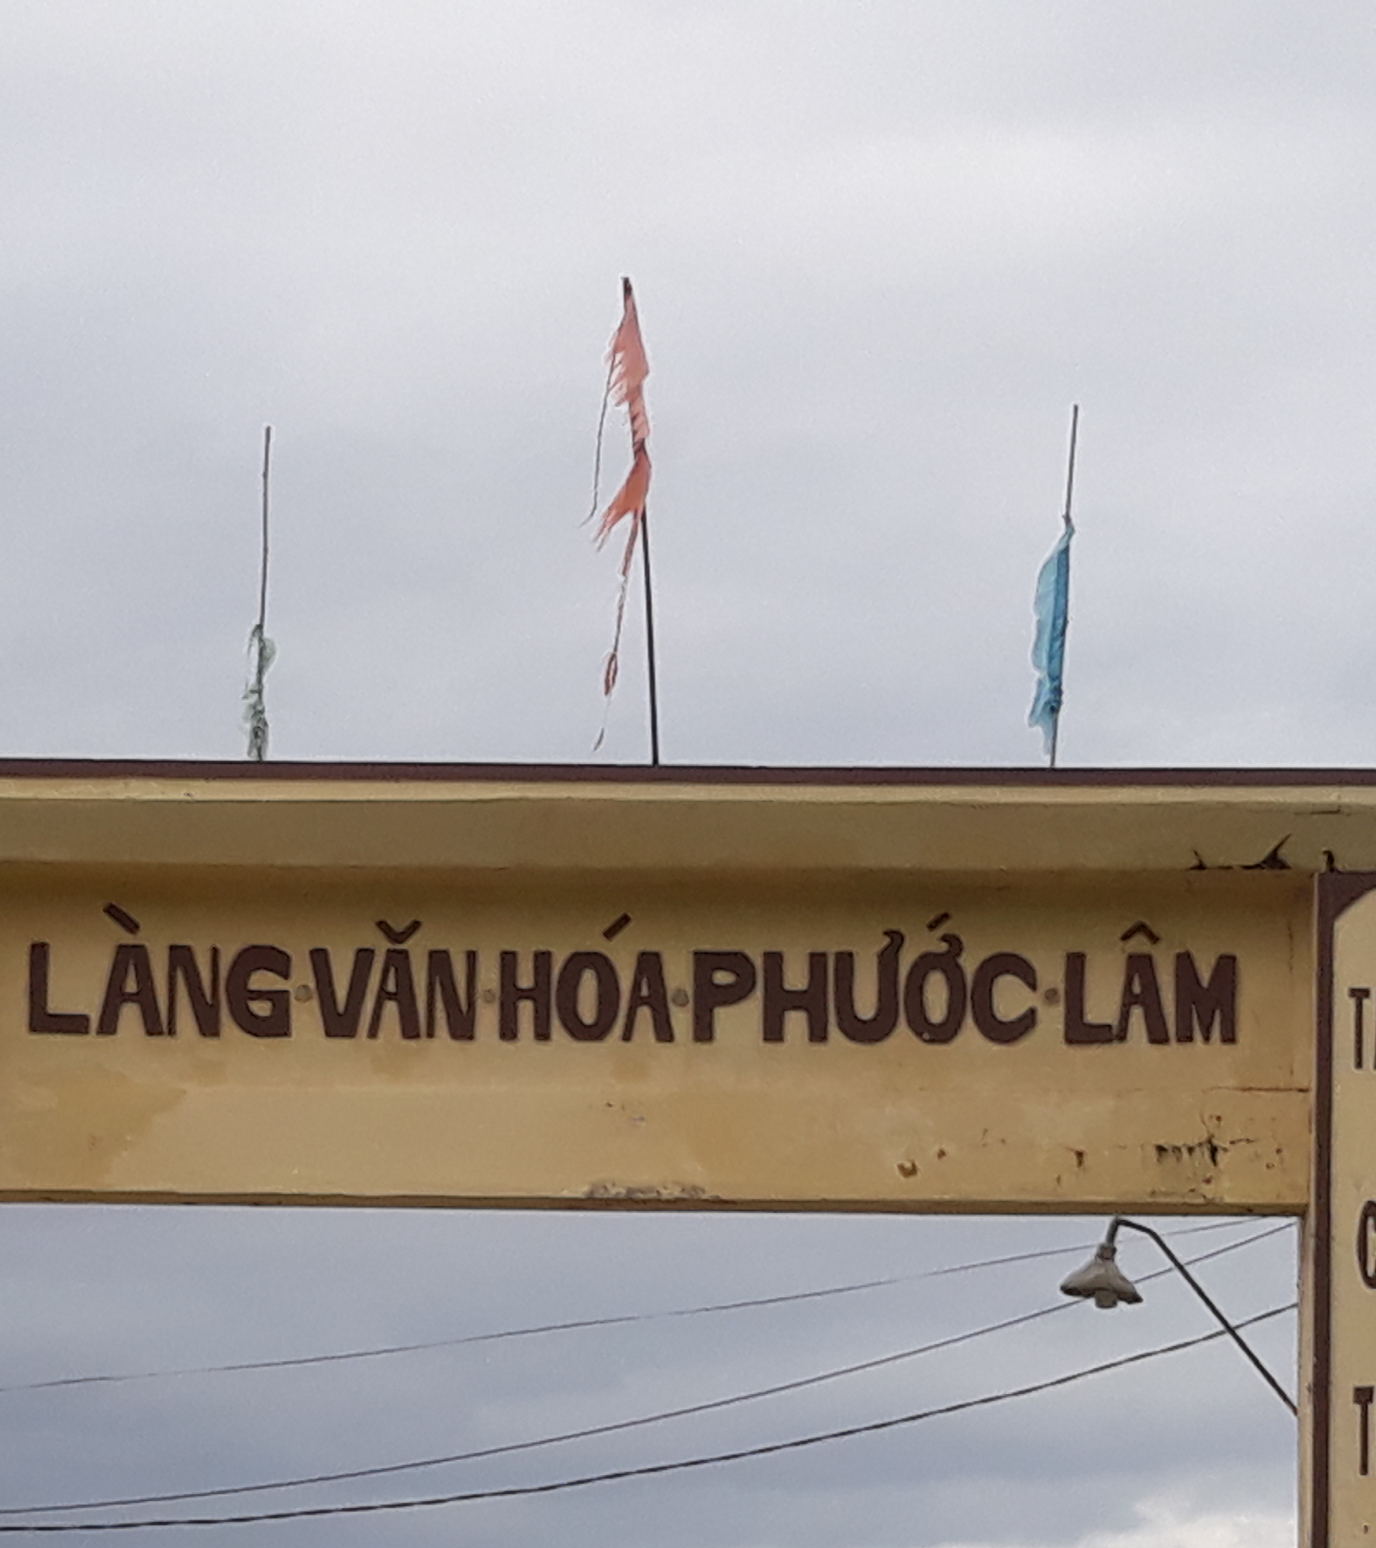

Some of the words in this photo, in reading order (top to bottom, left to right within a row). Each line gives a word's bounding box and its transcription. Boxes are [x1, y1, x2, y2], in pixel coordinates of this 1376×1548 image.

[27, 901, 293, 1039] LÀNG
[308, 918, 478, 1042] VĂN
[692, 904, 1039, 1046] PHƯỚC
[1063, 920, 1239, 1047] LÂM
